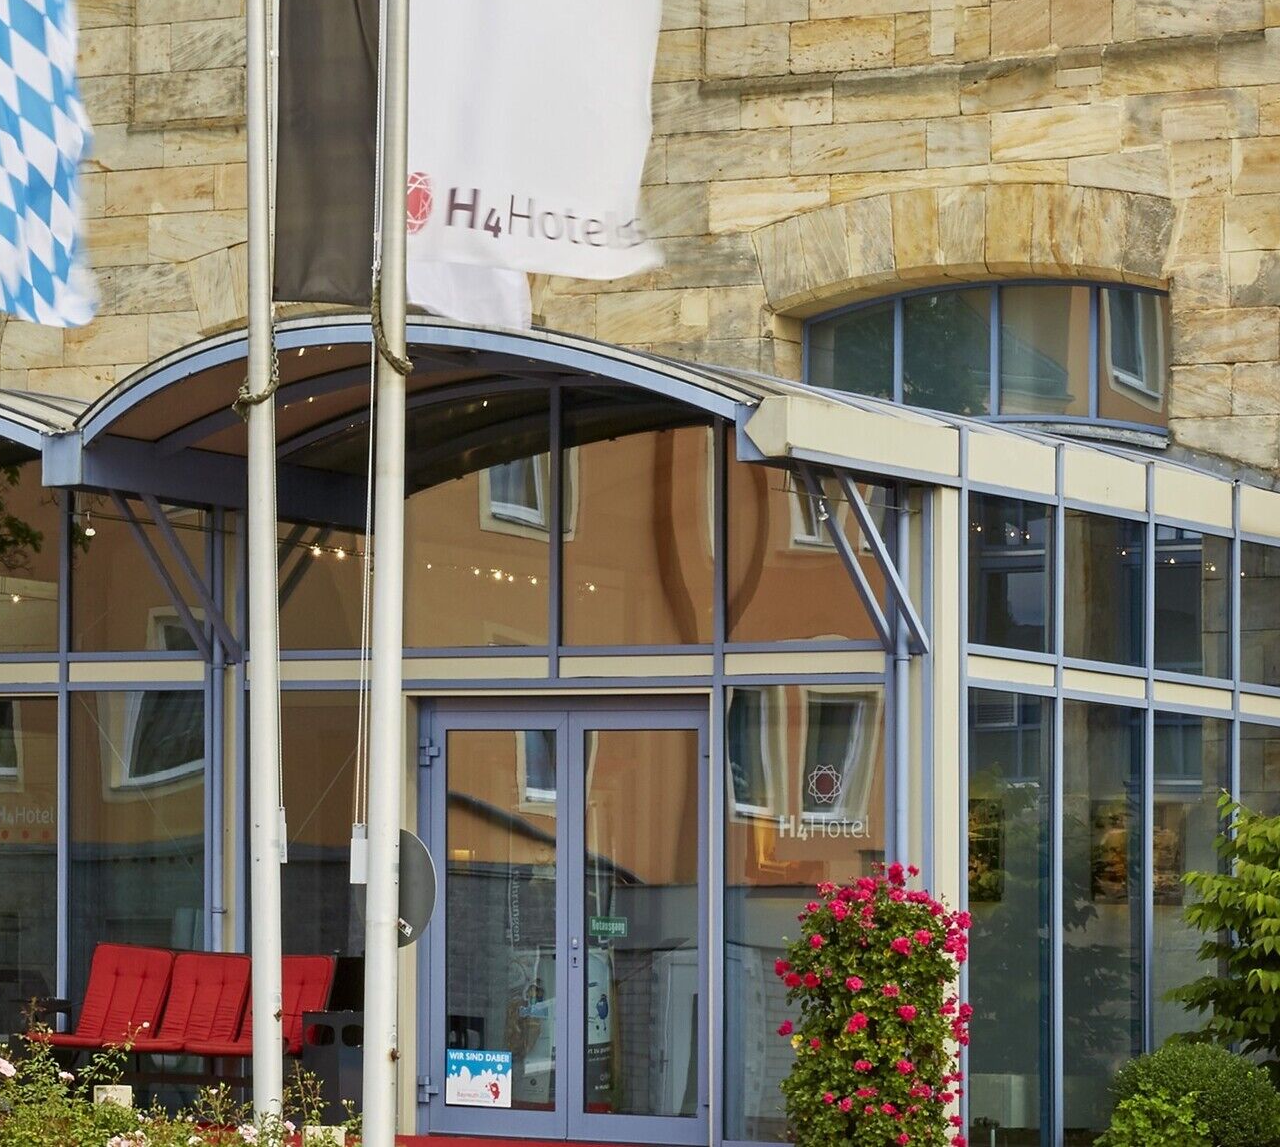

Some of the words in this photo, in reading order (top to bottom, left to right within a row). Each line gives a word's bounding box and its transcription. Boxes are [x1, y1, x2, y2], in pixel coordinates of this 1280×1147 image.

[779, 815, 871, 841] H4Hotel
[449, 1052, 465, 1060] WIR
[465, 1053, 484, 1062] SIND
